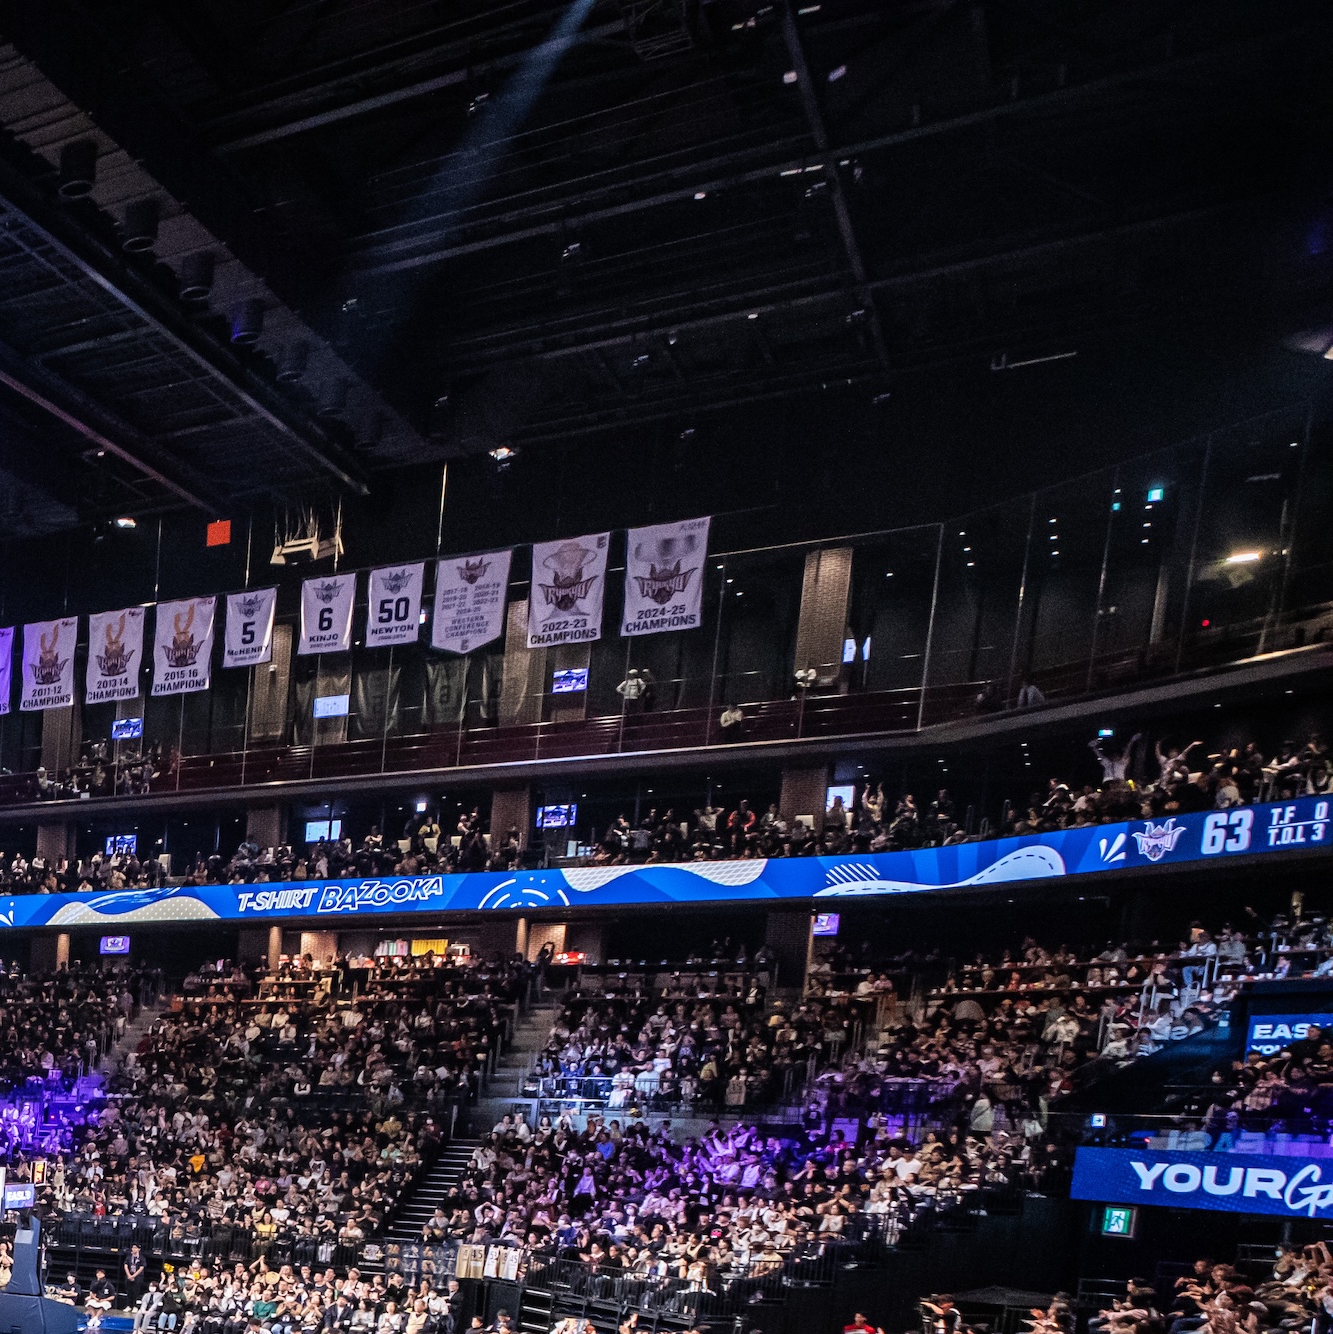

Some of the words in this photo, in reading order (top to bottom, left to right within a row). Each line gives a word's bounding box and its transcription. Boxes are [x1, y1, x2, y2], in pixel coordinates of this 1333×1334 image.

[378, 597, 409, 623] 50
[637, 605, 686, 620] 2024-25
[318, 608, 333, 631] 6
[542, 619, 587, 633] 2022-23
[625, 614, 696, 633] CHAMPIONS
[241, 621, 255, 644] 5
[371, 624, 414, 636] NEWTON
[445, 621, 489, 633] CONFERENCE
[309, 634, 338, 643] KINJO
[530, 629, 597, 645] CHAMPIONS
[227, 645, 270, 656] McHENRY
[164, 669, 198, 681] 2015-16
[96, 678, 128, 689] 2013-14
[154, 678, 207, 693] CHAMPIONS
[32, 685, 62, 697] 2011-12
[87, 687, 136, 700] CHAMPIONS
[23, 694, 71, 708] CHAMPIONS
[1201, 809, 1254, 854] 63
[1270, 806, 1296, 826] T.F
[1315, 801, 1329, 820] 0
[1268, 825, 1305, 846] T.O.L
[1311, 823, 1326, 841] 3
[238, 888, 318, 912] T-SHIRT
[317, 877, 443, 912] BAZOOKA
[7, 1190, 26, 1202] EASL
[1130, 1162, 1333, 1217] YOURG
